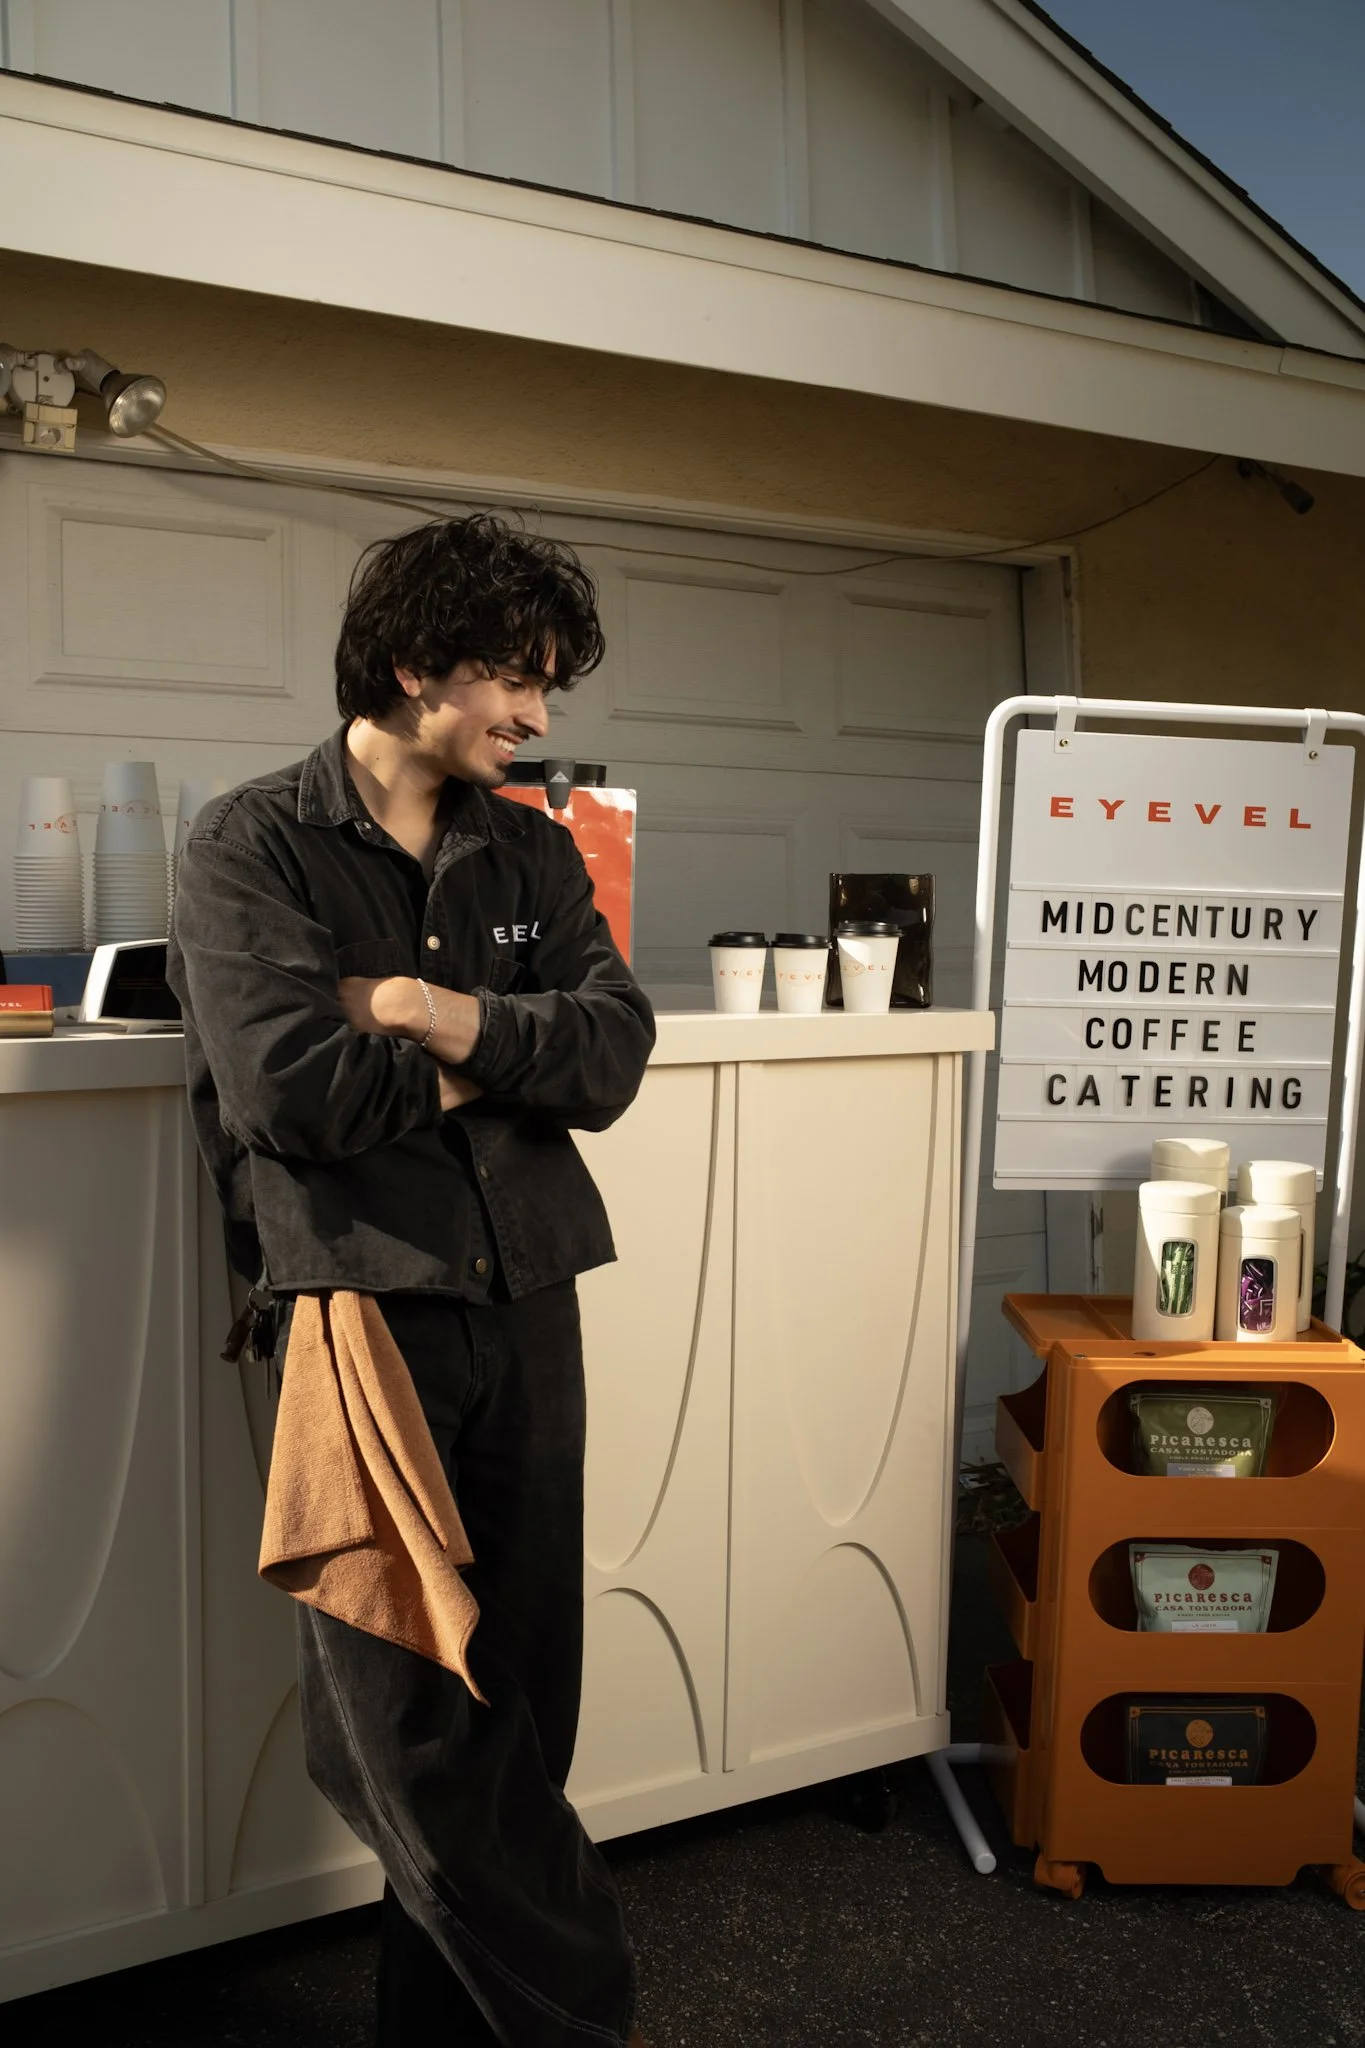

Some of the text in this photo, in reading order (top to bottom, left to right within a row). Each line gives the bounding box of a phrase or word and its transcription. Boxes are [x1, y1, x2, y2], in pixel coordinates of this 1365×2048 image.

[1050, 796, 1312, 829] EYEVEL
[1042, 900, 1319, 941] MIDCENTURY
[1078, 959, 1250, 996] MODERN
[1085, 1017, 1257, 1053] COFFEE
[1046, 1073, 1303, 1109] CATERING
[1185, 1448, 1253, 1457] TOSTADORA
[1185, 1761, 1249, 1769] TOSTADORA
